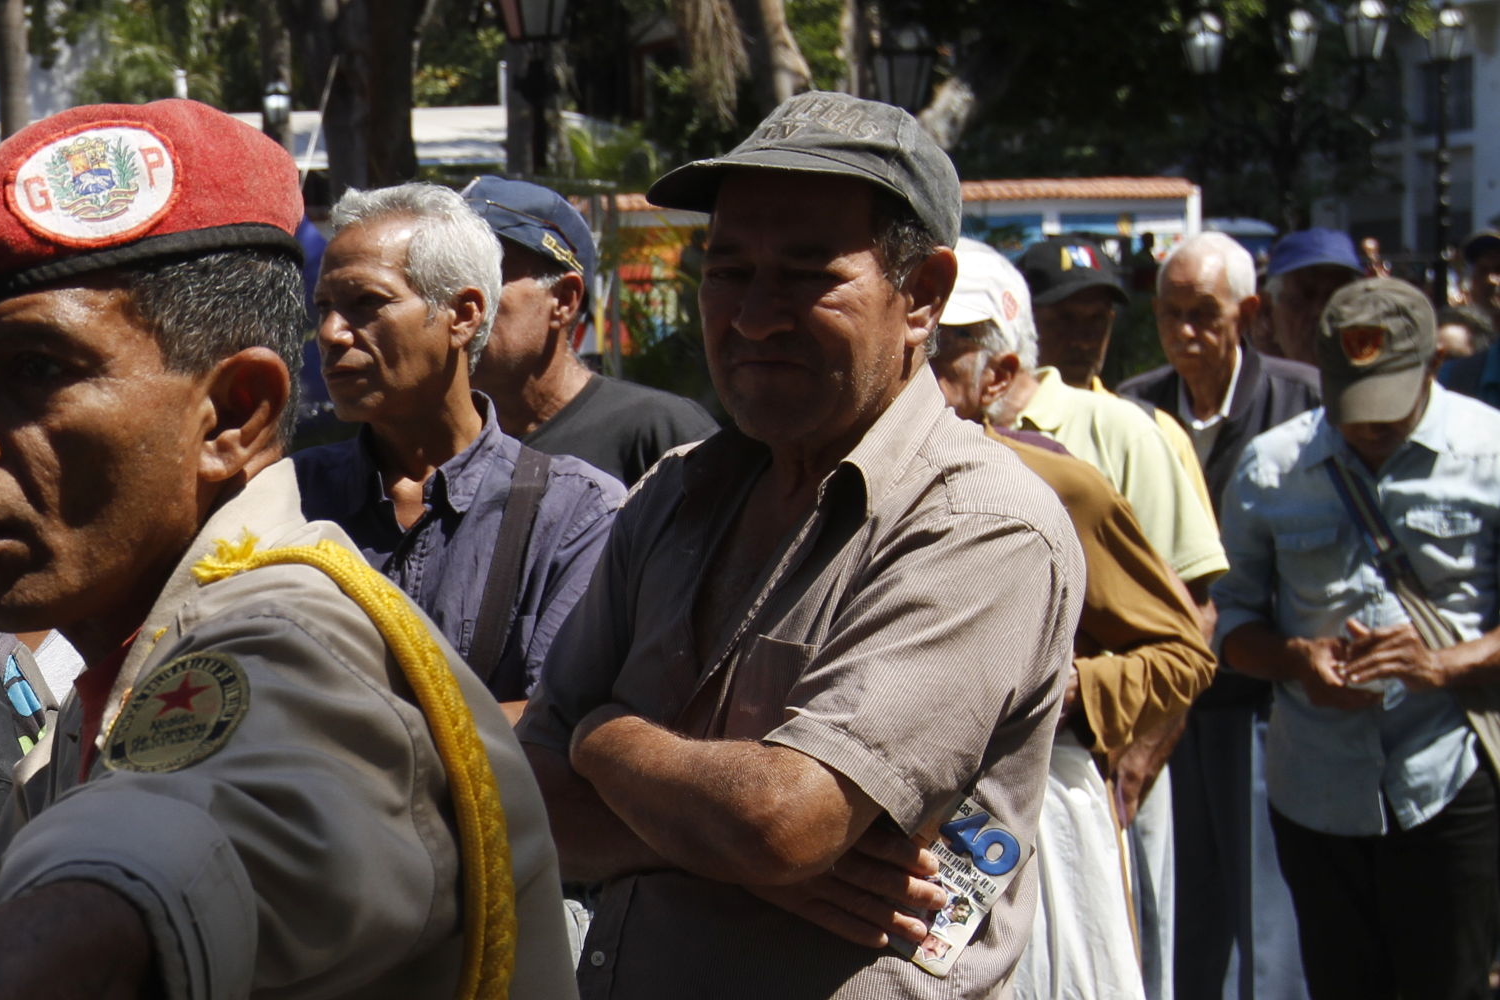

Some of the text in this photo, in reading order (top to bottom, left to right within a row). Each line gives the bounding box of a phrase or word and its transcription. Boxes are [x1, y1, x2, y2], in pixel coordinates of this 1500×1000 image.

[784, 95, 881, 140] VEGAS
[23, 146, 166, 213] G P
[939, 811, 1021, 877] 40
